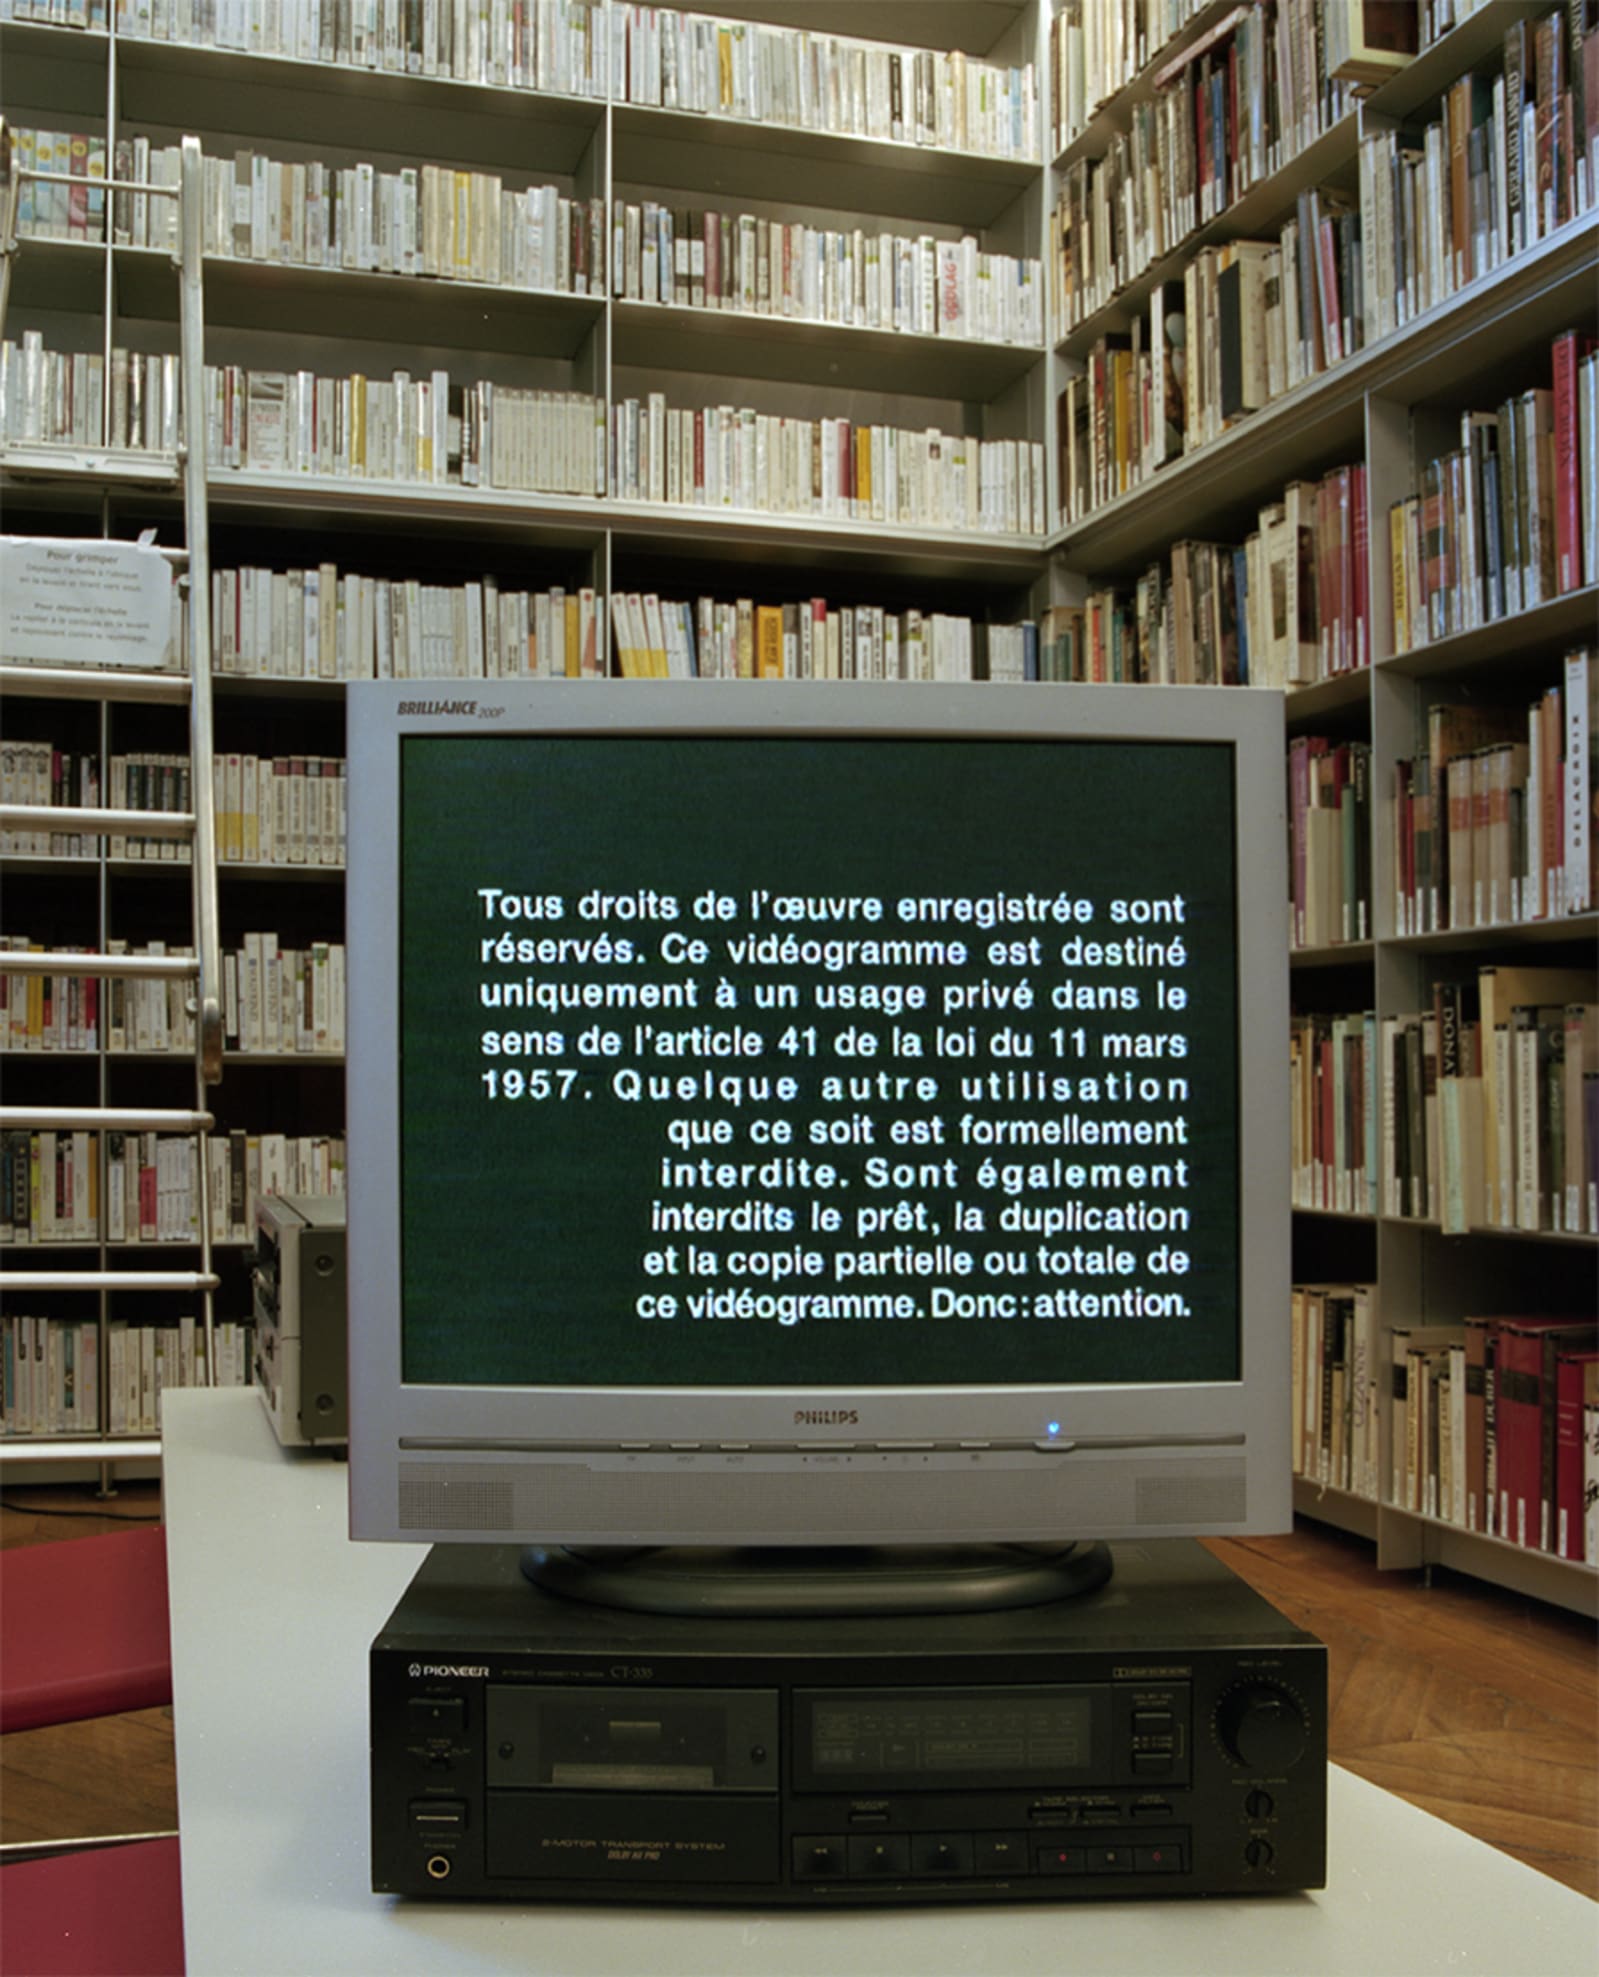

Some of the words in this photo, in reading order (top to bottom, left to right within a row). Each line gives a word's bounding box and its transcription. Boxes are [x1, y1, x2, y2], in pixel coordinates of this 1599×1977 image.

[1394, 552, 1404, 611] DEGAS
[397, 699, 478, 716] BRILLIANCE
[477, 888, 564, 920] Tous
[578, 889, 680, 921] droits
[693, 889, 737, 921] de
[751, 889, 883, 922] l'œuvre
[897, 891, 1094, 930] enregistrée
[1110, 894, 1185, 924] sont
[481, 931, 646, 964] réservés.
[660, 932, 710, 964] Ce
[726, 932, 968, 972] vidéogramme
[987, 936, 1042, 966] est
[1061, 935, 1187, 967] destiné
[480, 976, 698, 1014] uniquement
[714, 976, 738, 1009] à
[754, 984, 798, 1009] un
[815, 984, 926, 1017] usage
[943, 977, 1034, 1015] privé
[1051, 979, 1140, 1011] dans
[1157, 979, 1187, 1011] le
[481, 1030, 565, 1056] sens
[577, 1024, 622, 1056] de
[635, 1024, 763, 1057] l'article
[778, 1025, 817, 1057] 41
[834, 1025, 879, 1057] de
[892, 1025, 923, 1057] la
[936, 1026, 976, 1057] loi
[989, 1026, 1033, 1058] du
[1050, 1027, 1085, 1058] 11
[1102, 1033, 1187, 1058] mars
[481, 1068, 592, 1101] 1957.
[612, 1068, 799, 1107] Quelque
[821, 1071, 938, 1102] autre
[961, 1070, 1188, 1102] utilisation
[667, 1119, 734, 1151] que
[749, 1119, 792, 1144] ce
[809, 1113, 875, 1145] soit
[889, 1115, 945, 1145] est
[959, 1113, 1188, 1145] formellement
[661, 1157, 849, 1189] interdite.
[864, 1156, 958, 1189] Sont
[976, 1157, 1188, 1196] également
[652, 1200, 795, 1232] interdits
[811, 1200, 842, 1232] le
[857, 1200, 940, 1239] prêt,
[954, 1200, 985, 1232] la
[999, 1200, 1189, 1238] duplication
[643, 1245, 679, 1276] et
[688, 1244, 719, 1276] la
[727, 1244, 824, 1282] copie
[834, 1244, 974, 1282] partielle
[983, 1251, 1028, 1276] ou
[1036, 1244, 1137, 1276] totale
[1146, 1244, 1190, 1275] de
[636, 1294, 679, 1319] ce
[794, 1410, 859, 1425] PHILIPS
[423, 1665, 490, 1678] PIONEER
[601, 1839, 671, 1850] TRANSPORT
[674, 1841, 726, 1851] SYSTEM
